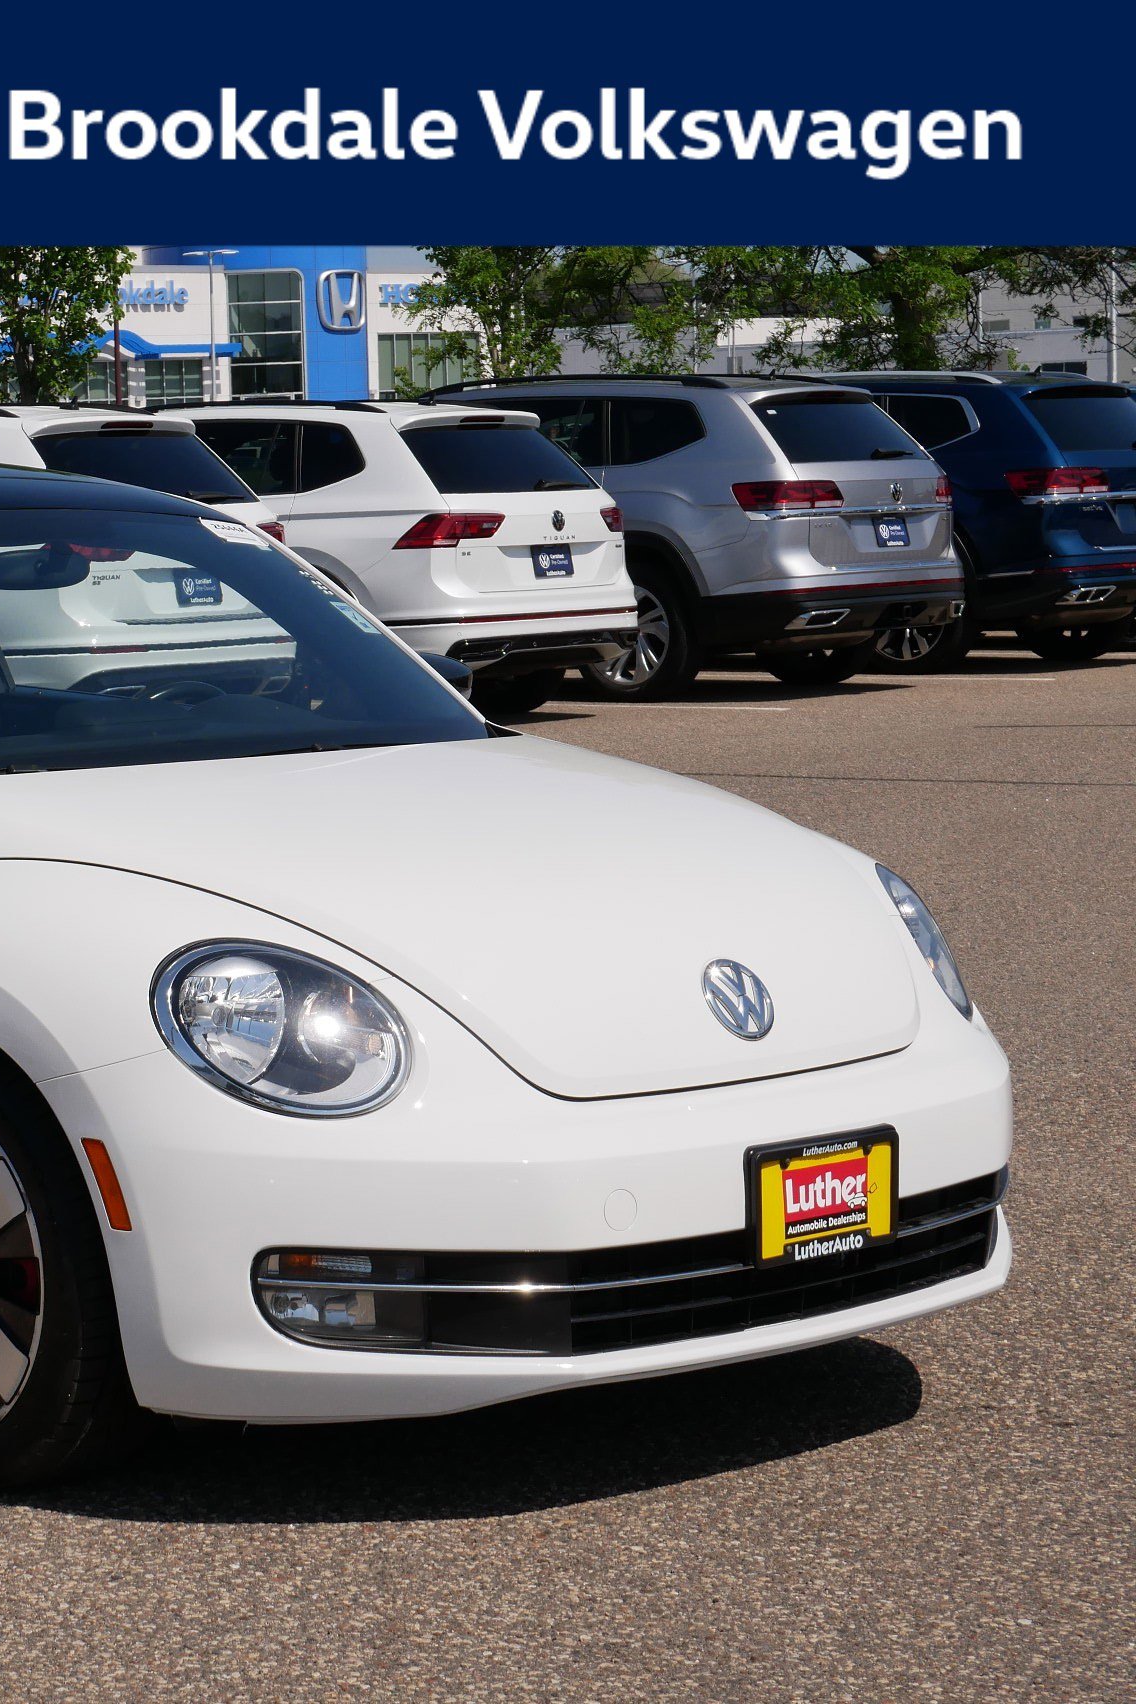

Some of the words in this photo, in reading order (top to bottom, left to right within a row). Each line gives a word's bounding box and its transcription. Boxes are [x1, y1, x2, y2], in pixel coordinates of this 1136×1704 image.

[803, 1140, 858, 1157] LutherAuto.com
[785, 1171, 867, 1214] Luther
[787, 1219, 828, 1235] Automobile
[828, 1211, 866, 1226] Dealerships
[794, 1233, 864, 1261] LutherAuto
